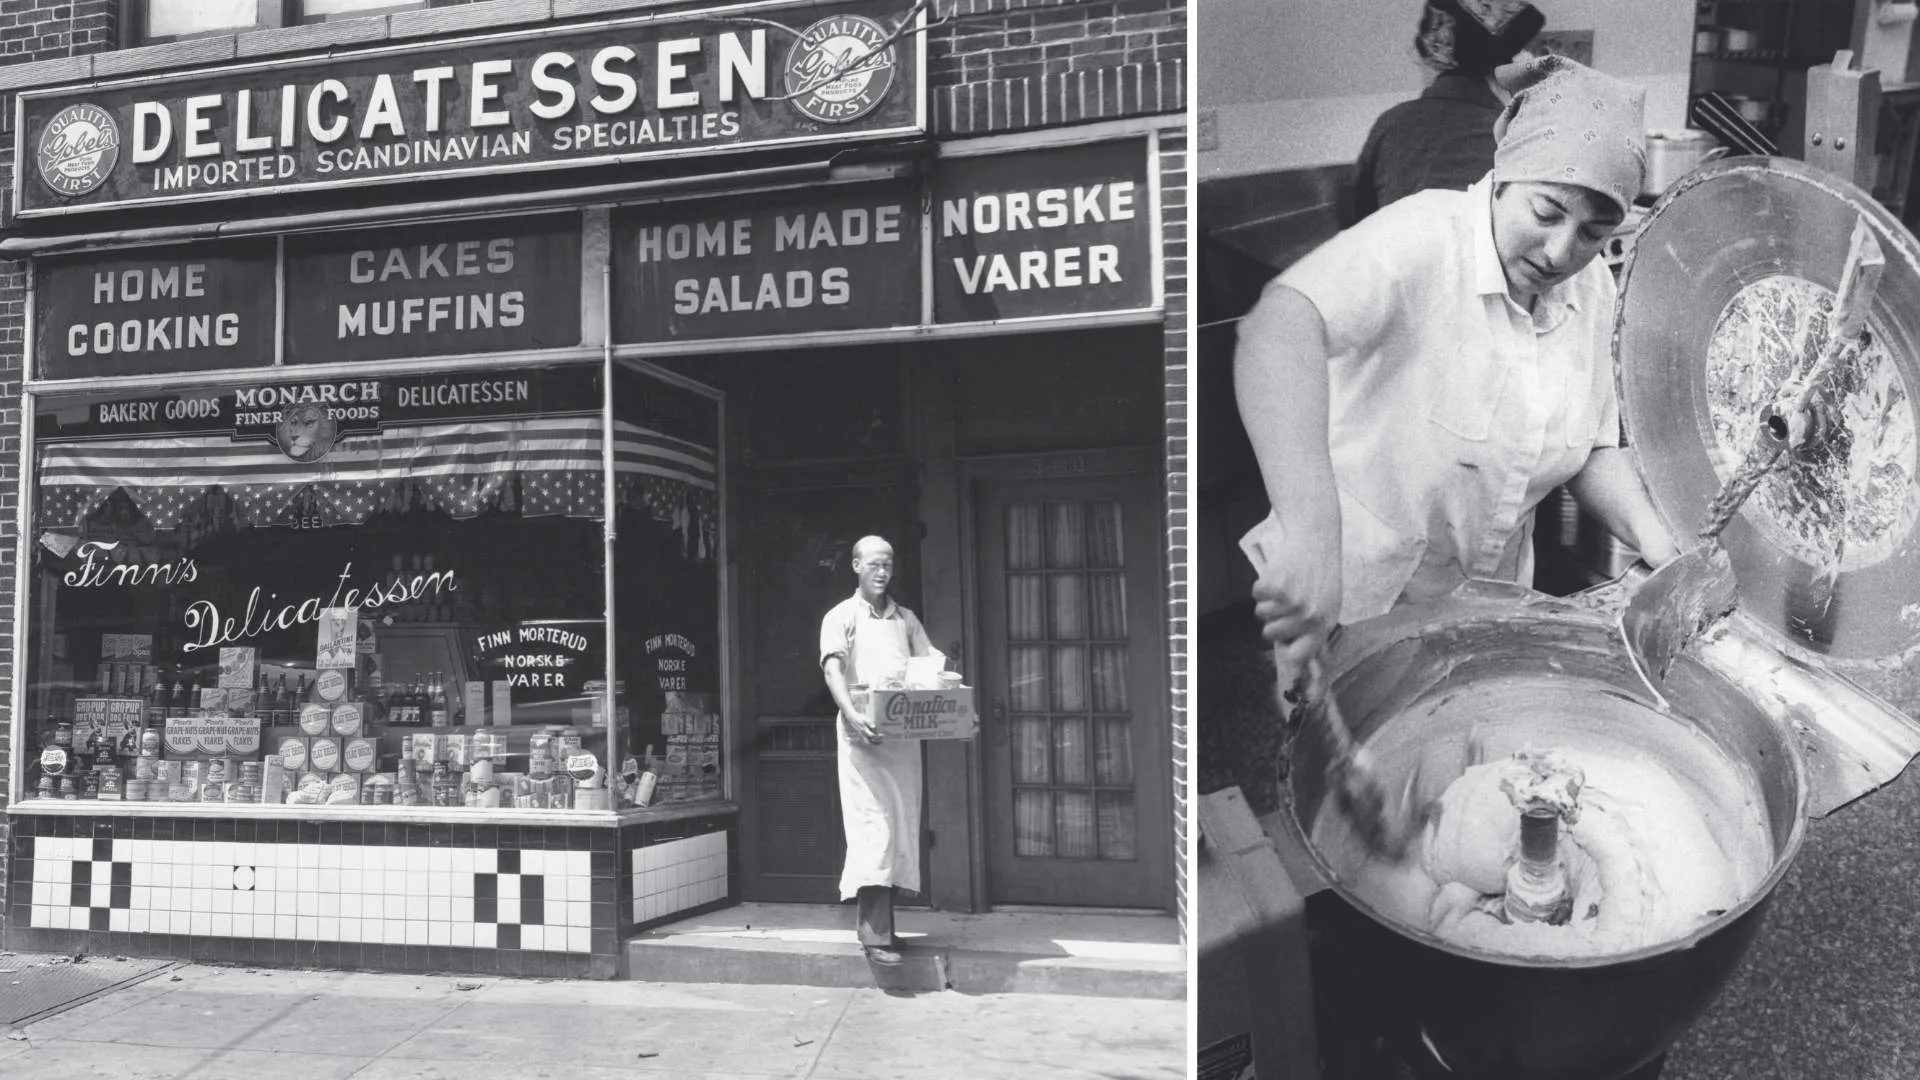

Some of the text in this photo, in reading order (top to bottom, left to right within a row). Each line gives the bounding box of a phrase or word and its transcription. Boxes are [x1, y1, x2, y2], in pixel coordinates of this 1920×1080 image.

[803, 21, 882, 51] QUALITY
[132, 28, 767, 165] DELICATESSEN
[806, 90, 871, 117] FIRST
[51, 108, 110, 135] QUALITY
[154, 112, 740, 190] IMPORTED SCANDINAVIAN SPECIALTIES
[53, 167, 101, 190] FIRST
[943, 181, 1135, 237] NORSKE
[639, 205, 900, 262] HOME MADE
[350, 238, 515, 284] CAKES
[954, 244, 1122, 295] VARER
[94, 263, 206, 304] HOME
[674, 267, 850, 314] SALADS
[337, 290, 525, 339] MUFFINS
[67, 312, 240, 356] COOKING
[235, 381, 380, 408] MONARCH
[398, 380, 528, 408] DELICATESSEN
[100, 399, 221, 424] BAKERY GOODS
[235, 406, 379, 426] FINER FOODS
[64, 540, 198, 587] Finn's
[182, 561, 457, 652] Delicatessen
[477, 627, 588, 652] FINN MORTERUD
[645, 633, 696, 657] FINN MORTERUD
[505, 654, 565, 668] NORSKE
[658, 658, 686, 673] NORSKE
[507, 673, 565, 688] VARER
[659, 676, 687, 690] VARER
[903, 714, 938, 730] MILK
